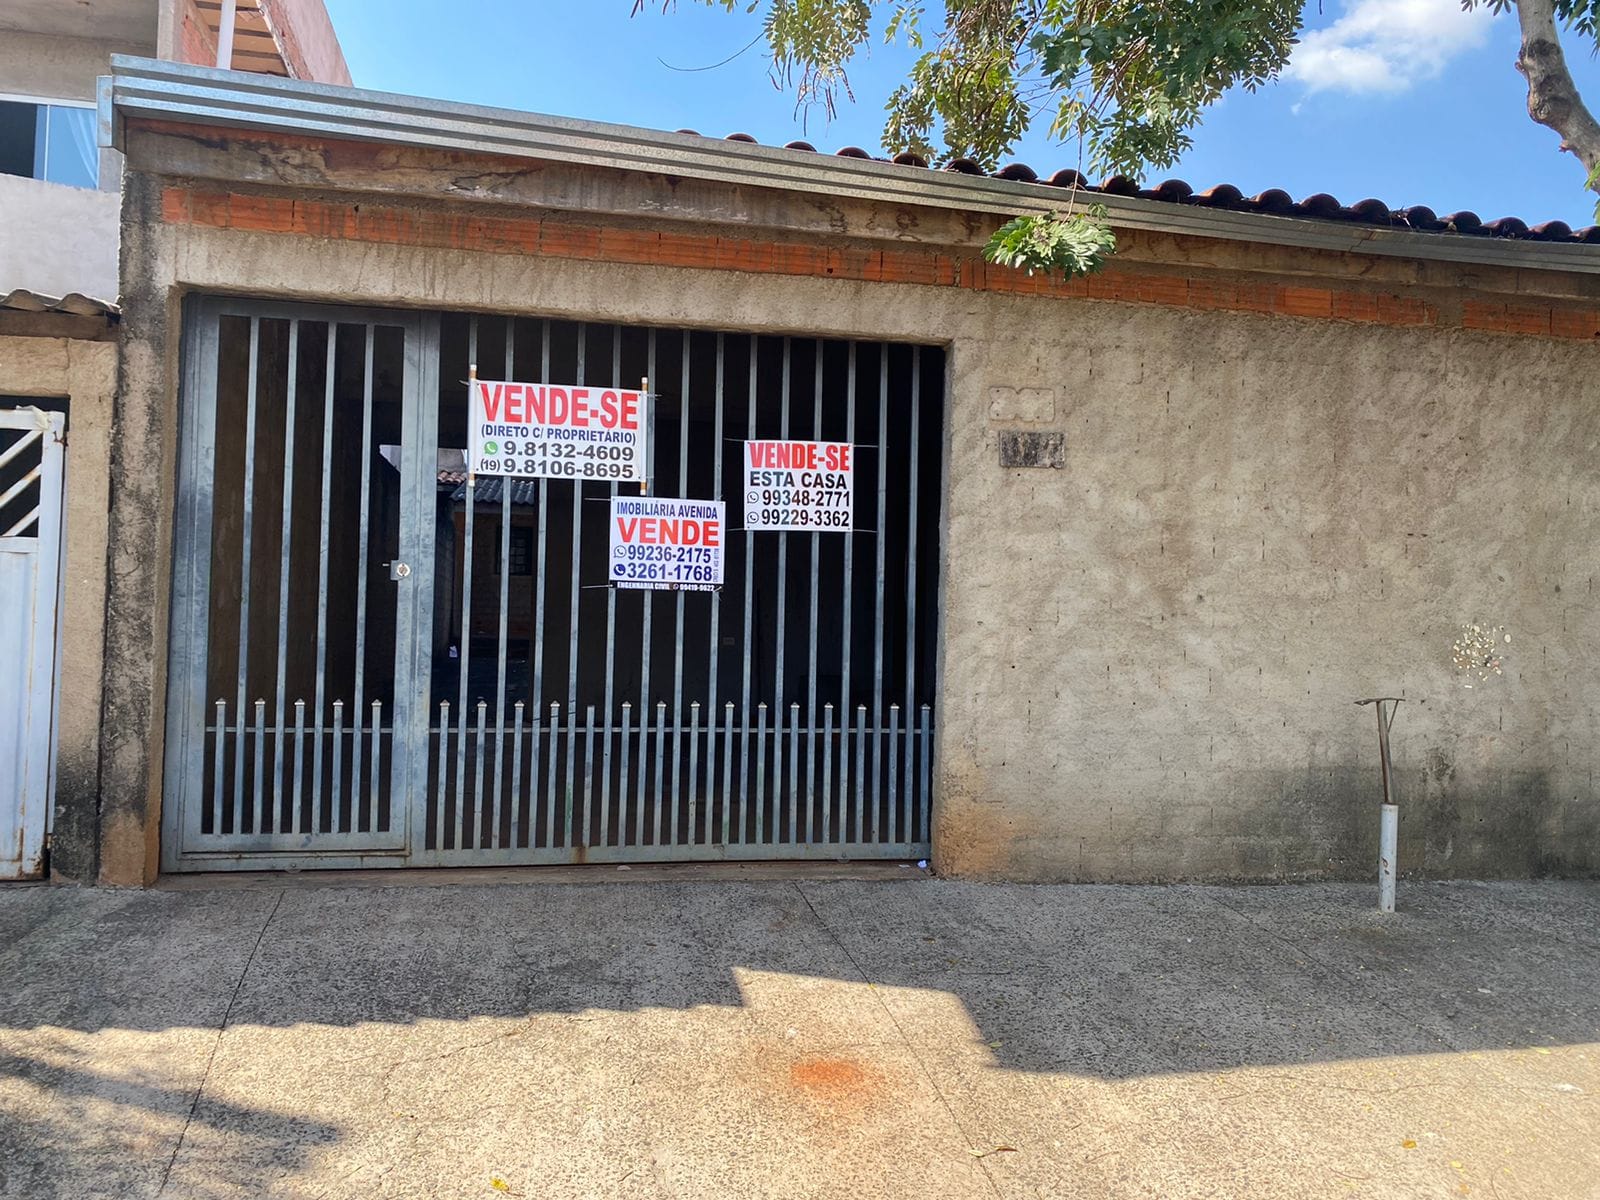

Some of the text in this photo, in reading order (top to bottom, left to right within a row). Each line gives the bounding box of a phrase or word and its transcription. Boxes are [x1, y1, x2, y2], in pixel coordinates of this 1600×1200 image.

[480, 383, 638, 430] VENDE-SE
[481, 424, 636, 446] (DIRETO C/ PROPRIETÁRIO)
[504, 440, 634, 461] 9.8132-4609
[749, 442, 850, 471] VENDE-SE
[480, 458, 634, 479] (19) 9.8106-8695
[750, 471, 847, 489] ESTA CASA
[762, 489, 850, 507] 99348-2771
[678, 505, 718, 519] AVENIDA
[761, 509, 850, 527] 99229-3362
[616, 517, 719, 546] VENDE
[628, 545, 711, 563] 99236-2175
[627, 562, 713, 581] 3261-1768
